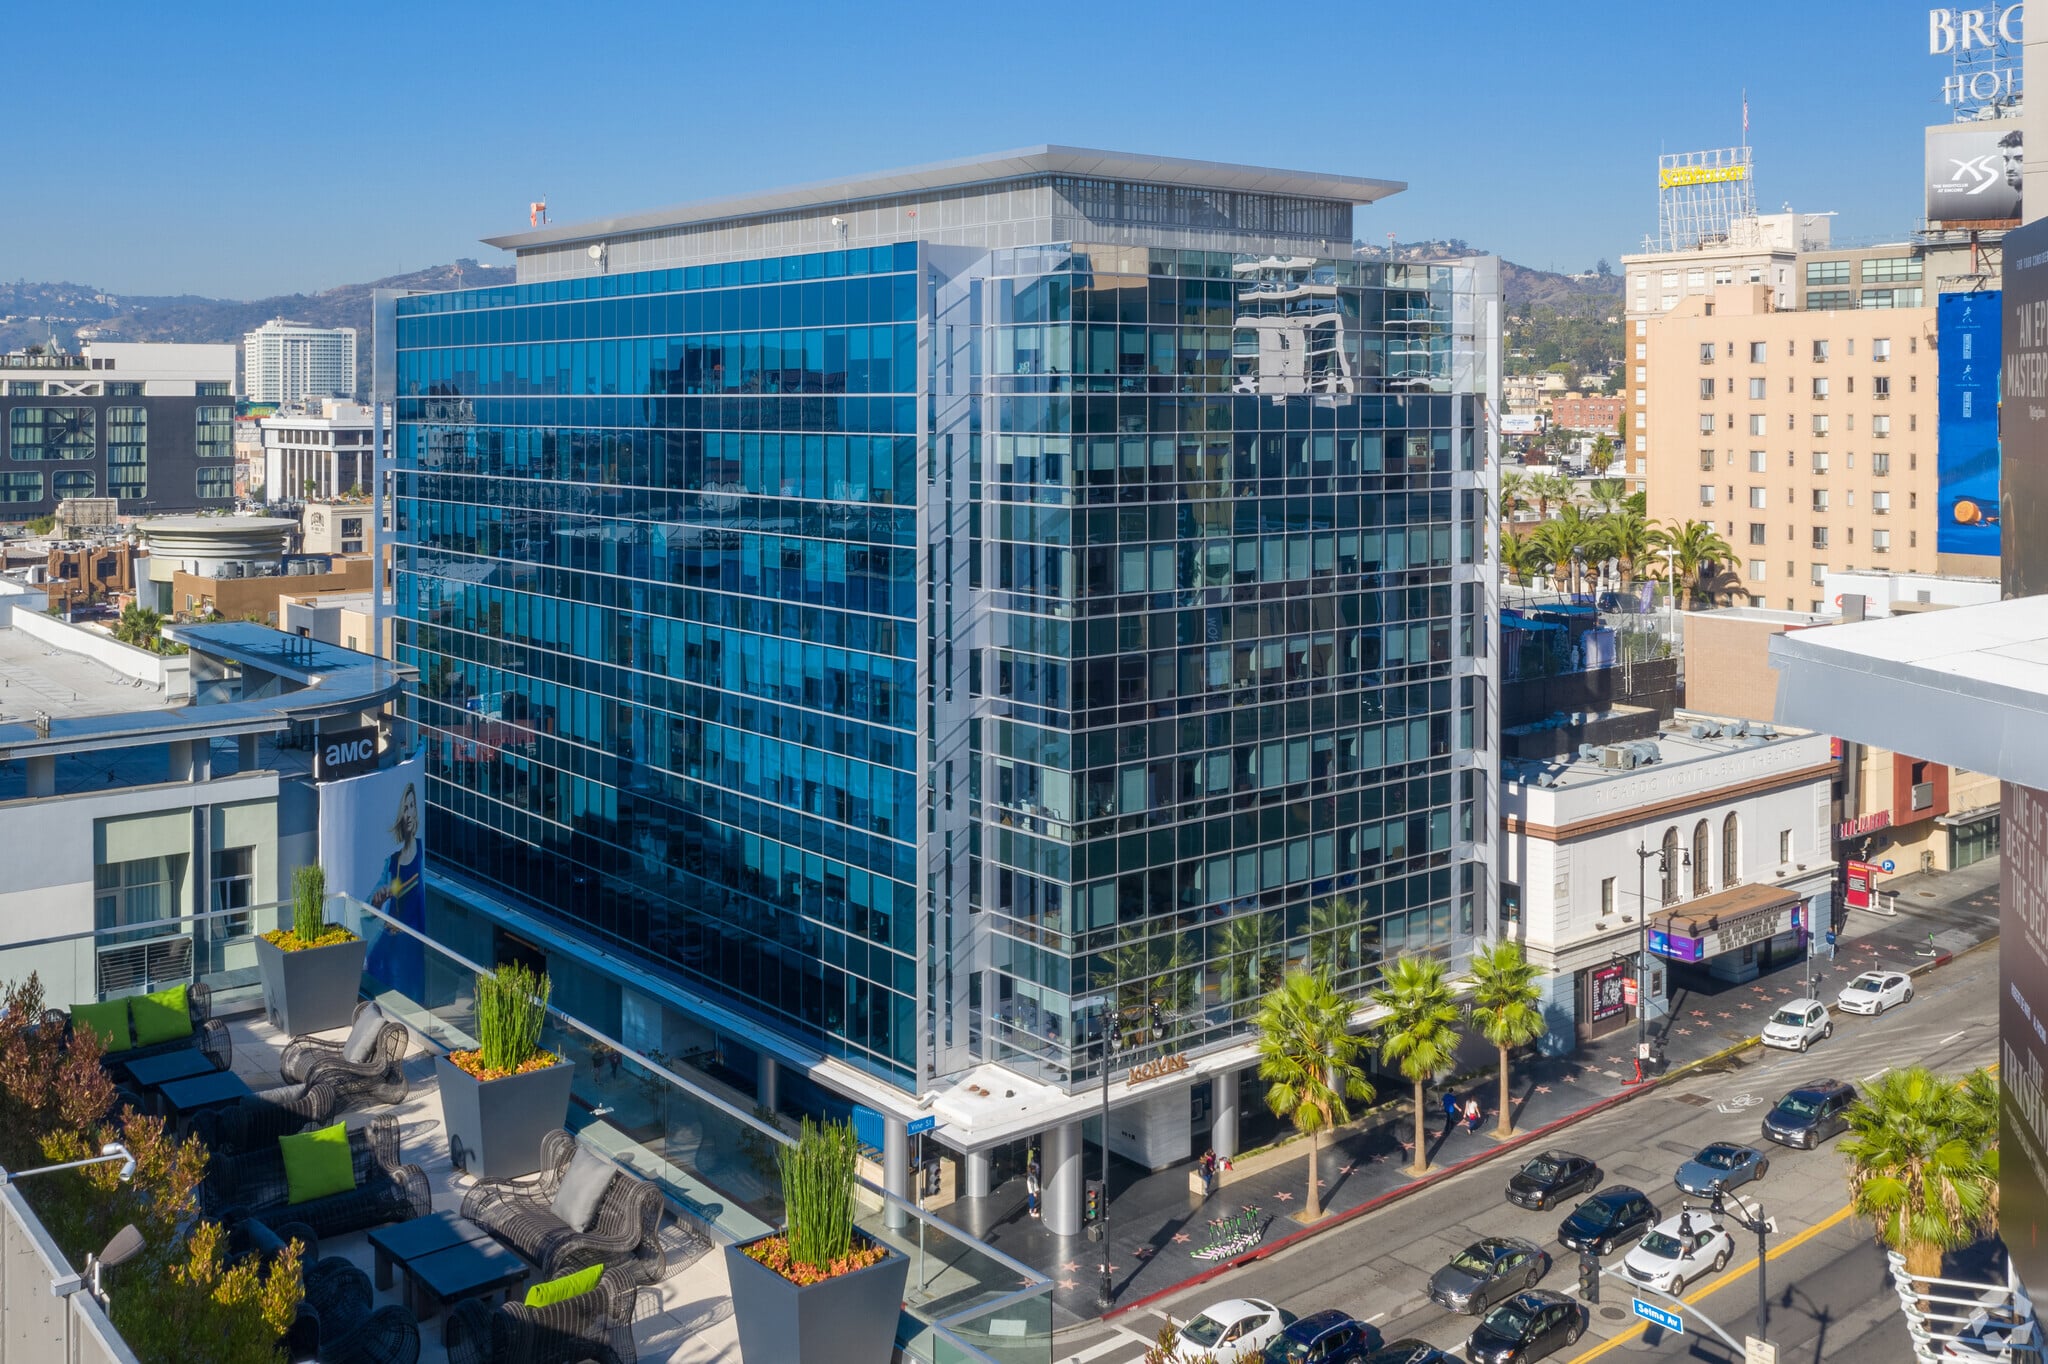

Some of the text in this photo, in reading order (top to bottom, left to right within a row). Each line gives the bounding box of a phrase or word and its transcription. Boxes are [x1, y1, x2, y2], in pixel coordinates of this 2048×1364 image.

[1950, 154, 1999, 195] XS
[1596, 777, 1658, 804] RICARDO
[1666, 760, 1746, 786] MONTALBAN
[1859, 809, 1889, 833] PARKING
[2032, 799, 2043, 846] OF
[2006, 817, 2026, 875] BEST
[2011, 866, 2028, 922] THE
[2030, 888, 2048, 950] DEC
[1638, 1303, 1678, 1327] Selma Av
